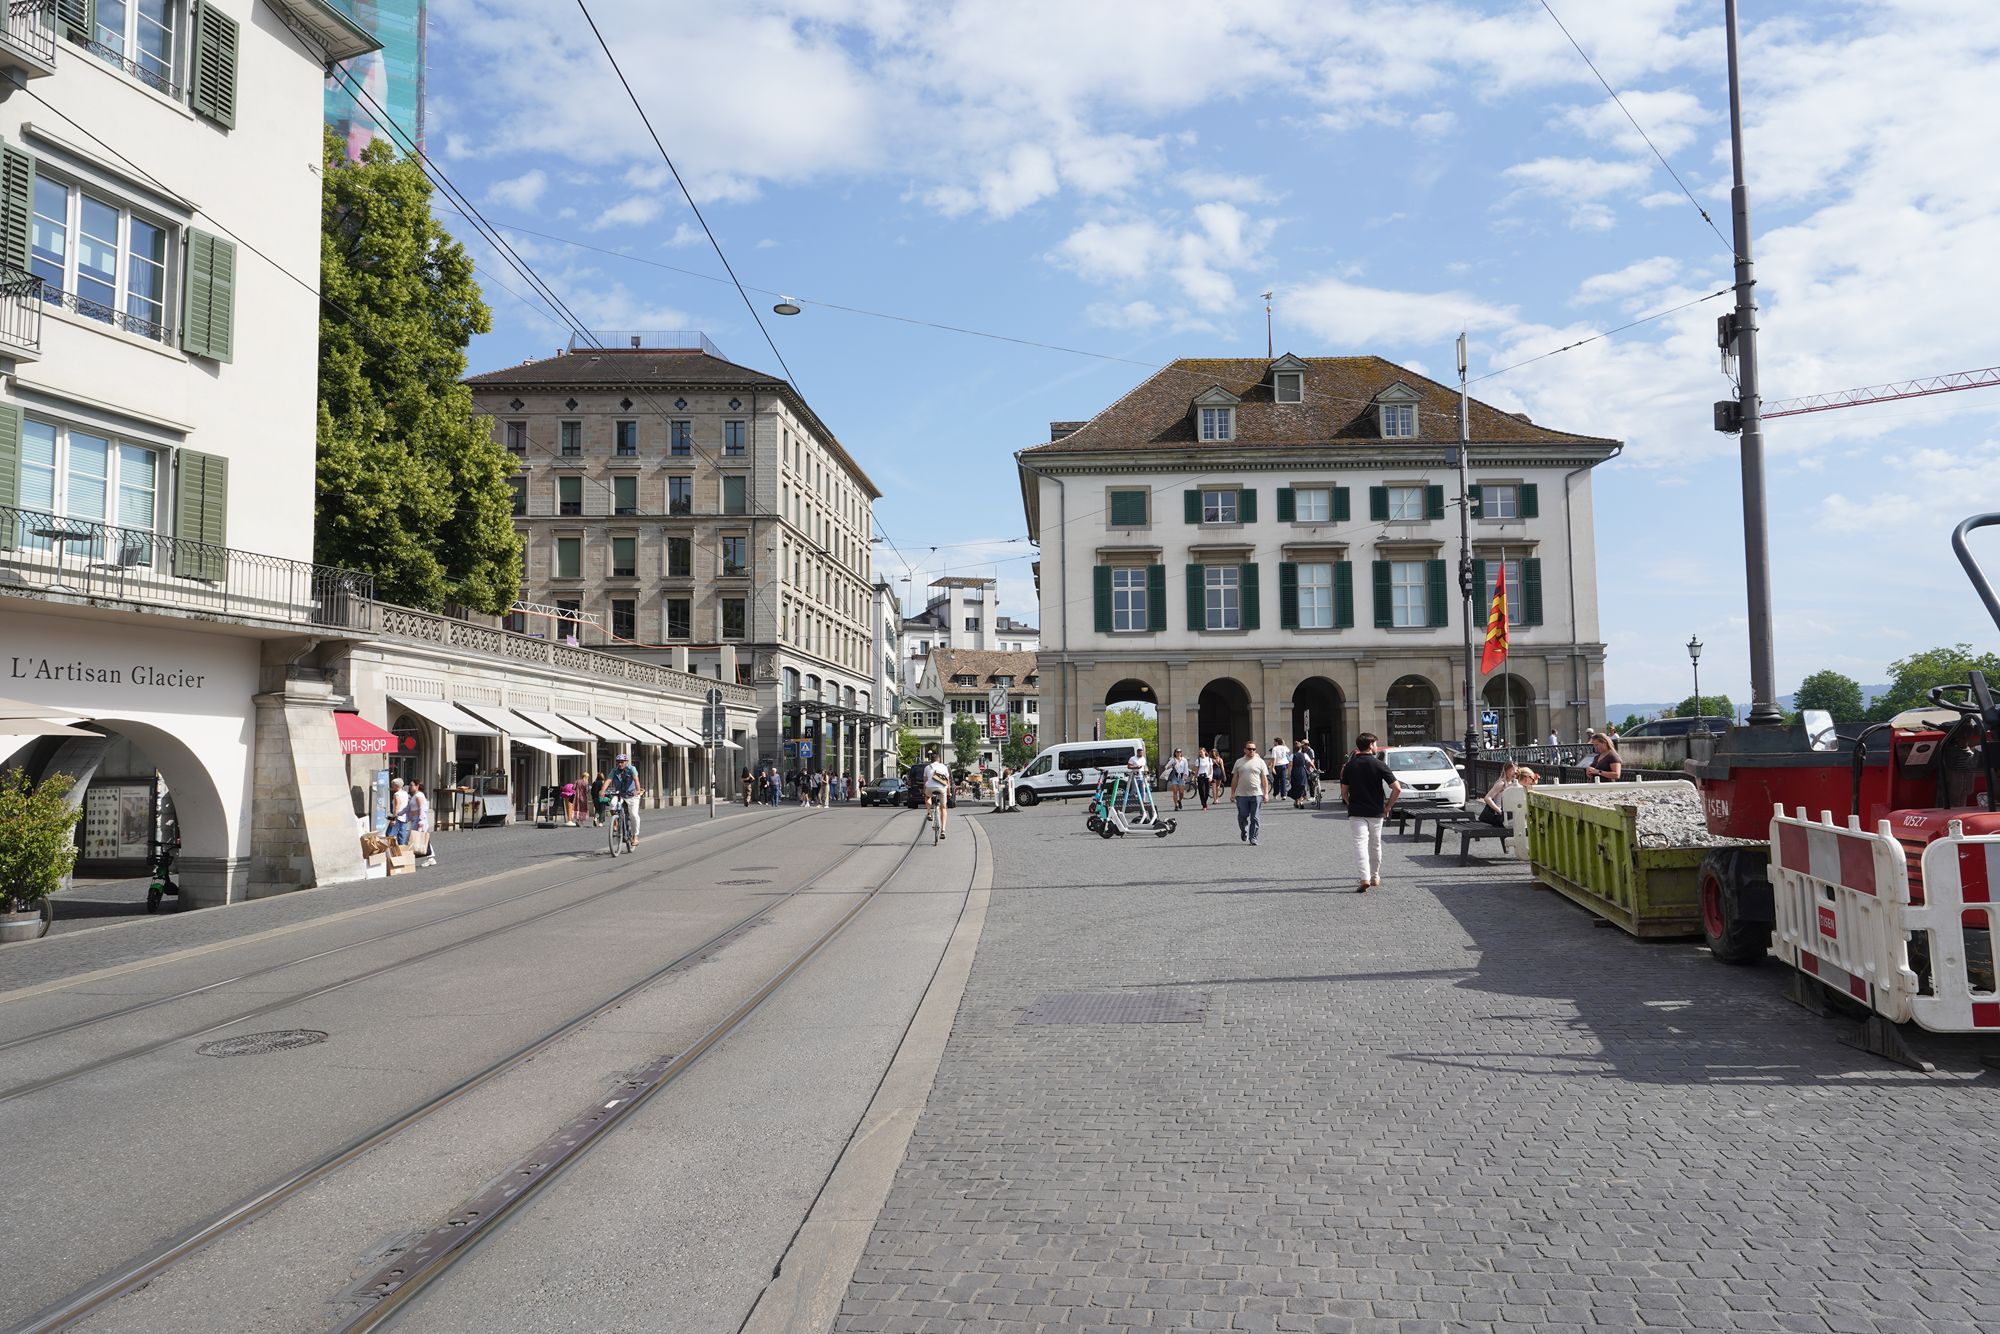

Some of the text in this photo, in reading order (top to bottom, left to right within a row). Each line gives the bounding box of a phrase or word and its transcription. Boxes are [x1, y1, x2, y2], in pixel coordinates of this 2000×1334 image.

[11, 657, 205, 688] L'Artisan Glacier
[1068, 773, 1082, 781] ICS
[1903, 815, 1928, 827] 10527
